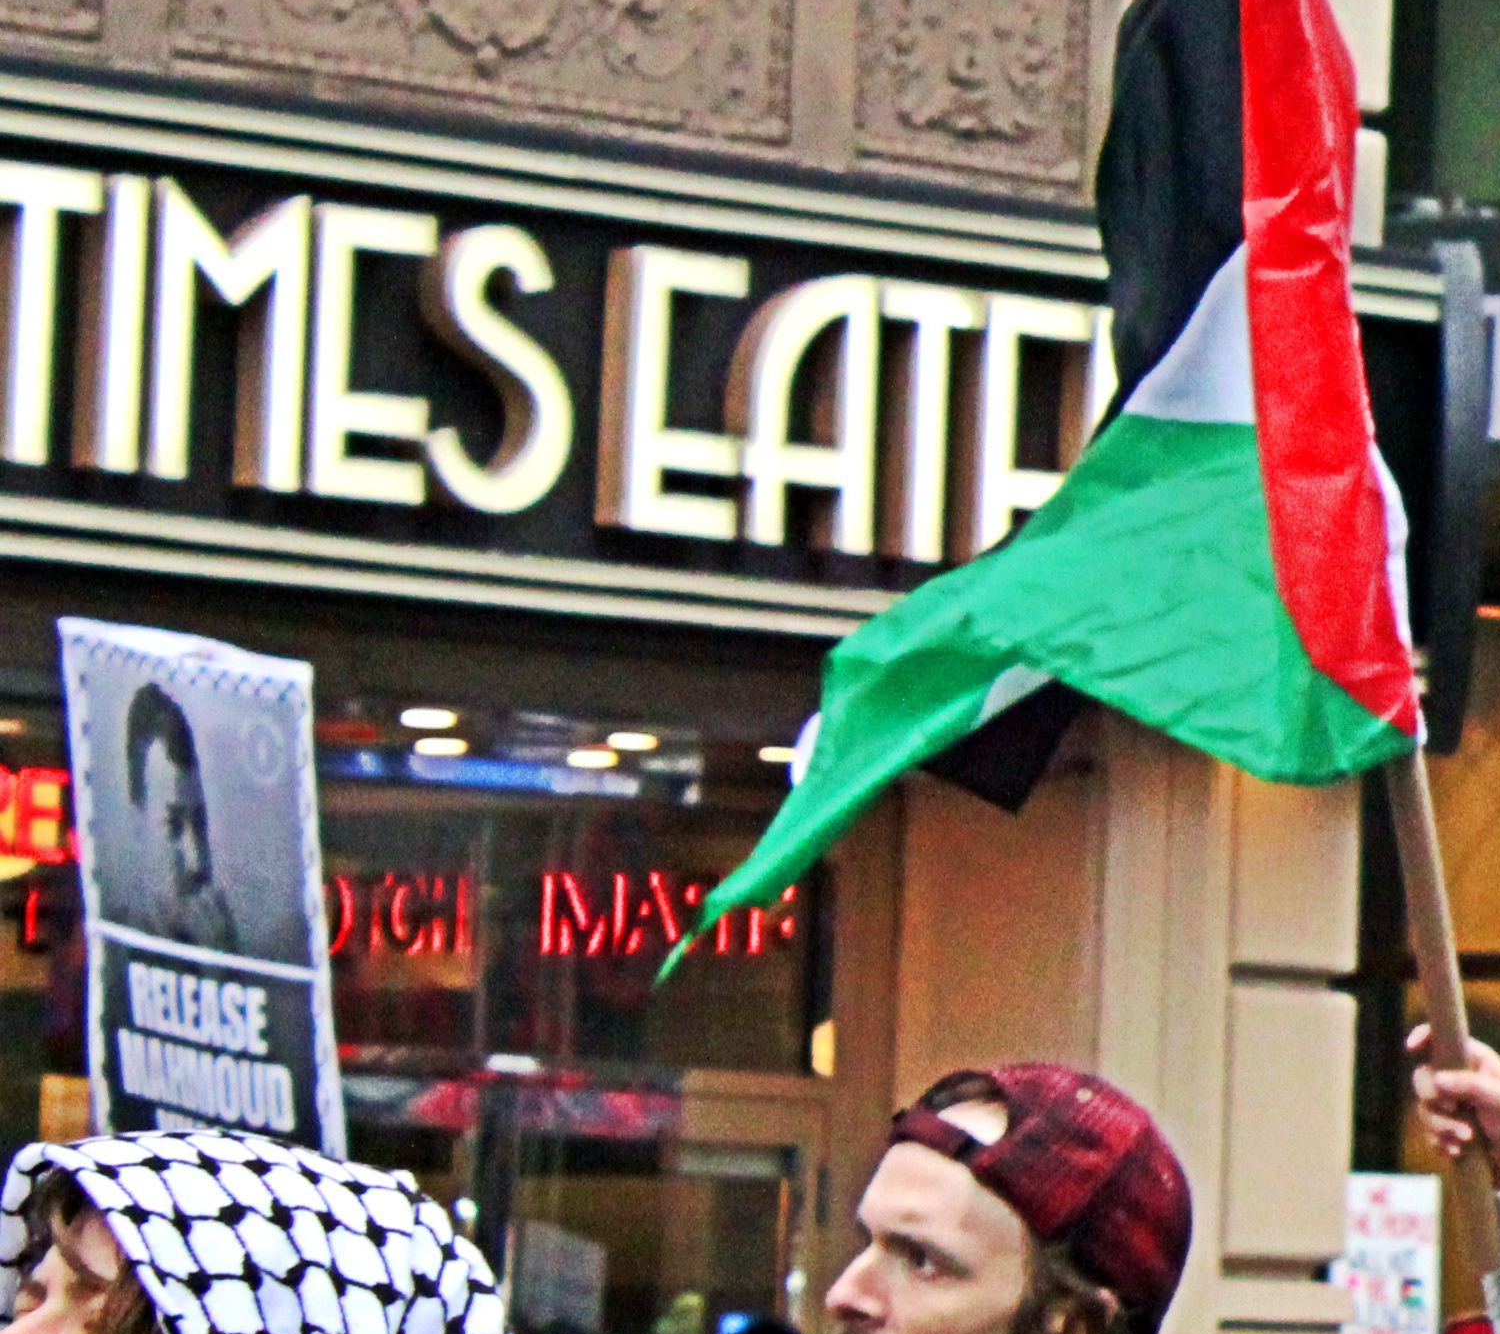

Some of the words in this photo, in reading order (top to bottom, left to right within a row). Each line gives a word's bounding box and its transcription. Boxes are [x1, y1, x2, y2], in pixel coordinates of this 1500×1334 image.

[0, 159, 574, 515] TIMES
[628, 244, 1118, 563] EATE
[129, 962, 269, 1057] RELEASE
